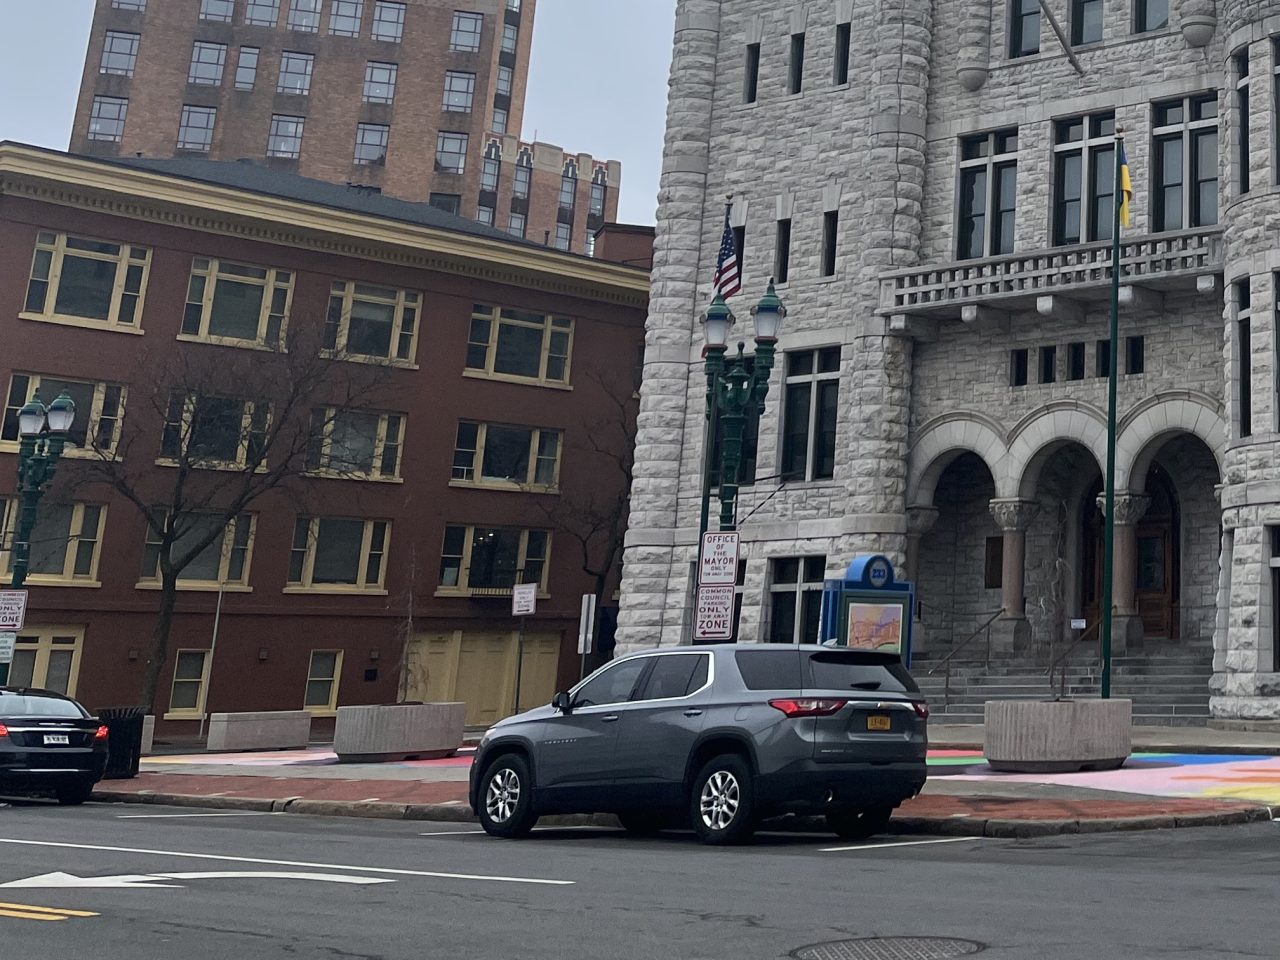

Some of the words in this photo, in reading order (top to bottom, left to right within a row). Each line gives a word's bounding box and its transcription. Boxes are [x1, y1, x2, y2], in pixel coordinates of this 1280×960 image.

[707, 535, 735, 544] OFFICE
[704, 557, 734, 566] MAYOR
[698, 620, 728, 630] ZONE
